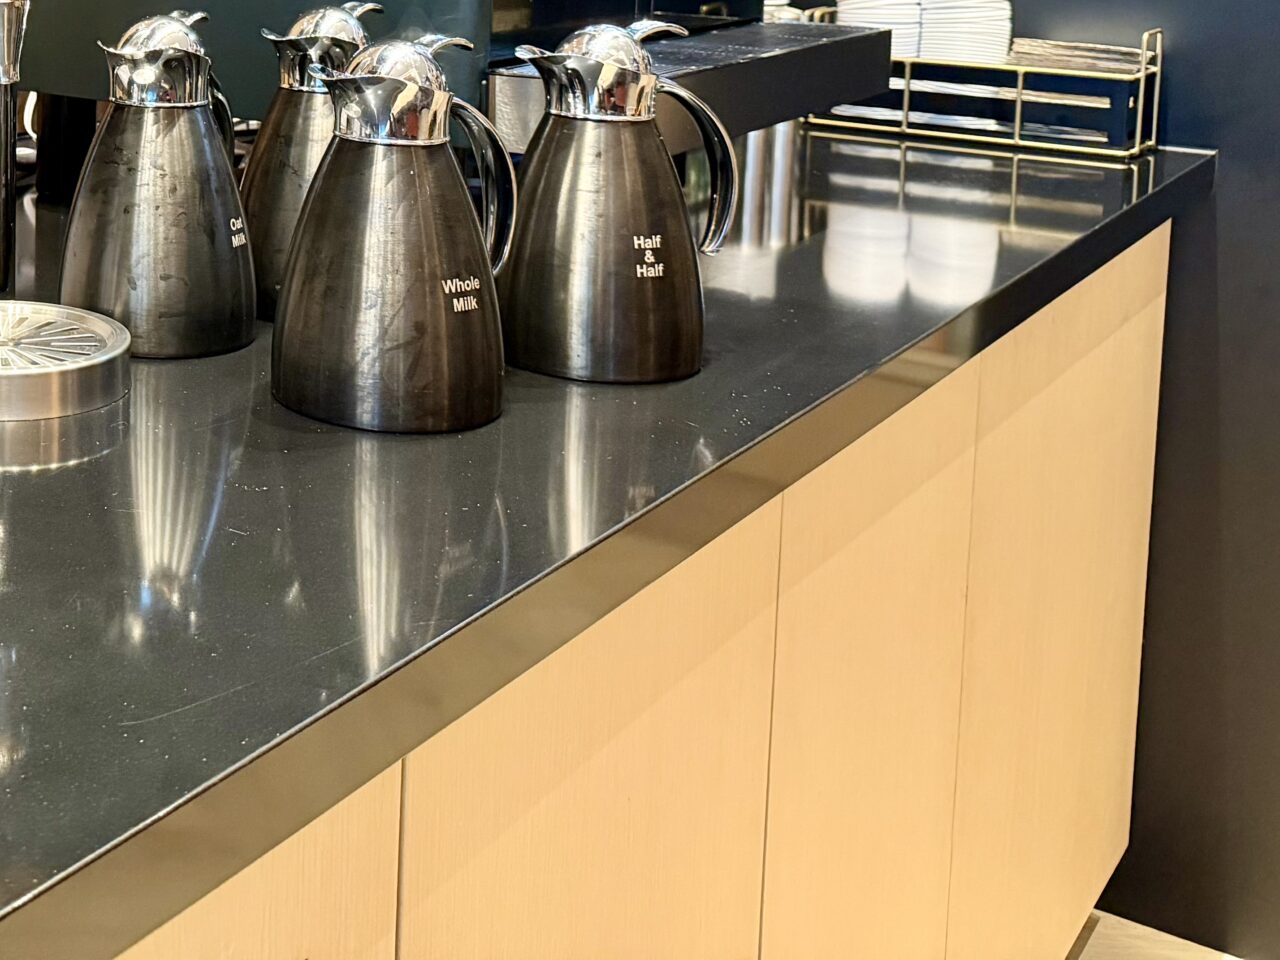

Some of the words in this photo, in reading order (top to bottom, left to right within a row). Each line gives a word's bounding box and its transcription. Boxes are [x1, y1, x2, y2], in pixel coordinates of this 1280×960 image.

[230, 216, 243, 231] Oat
[231, 232, 247, 248] Milk
[633, 234, 662, 249] Half
[644, 249, 655, 263] &
[636, 262, 664, 278] Half
[441, 275, 480, 294] Whole
[452, 295, 479, 312] Milk
